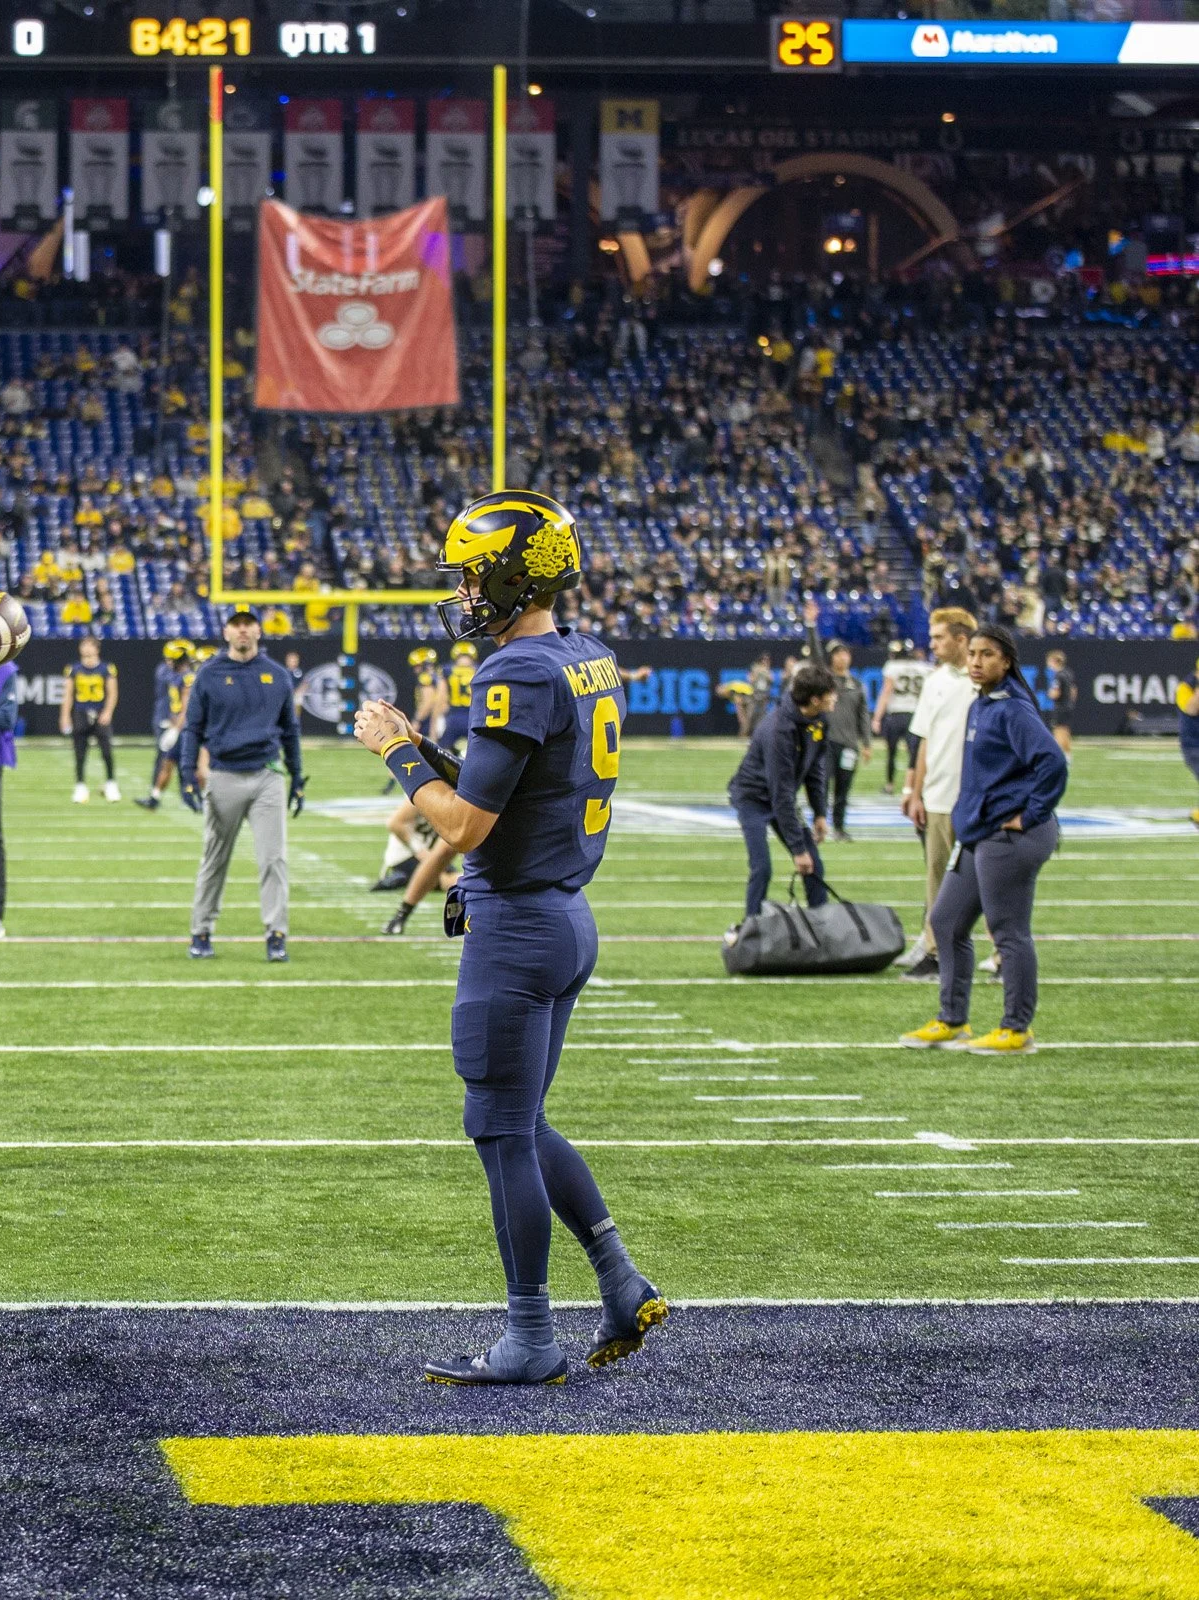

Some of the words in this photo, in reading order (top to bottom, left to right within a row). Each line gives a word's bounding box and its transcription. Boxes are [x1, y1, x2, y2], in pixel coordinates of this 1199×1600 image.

[13, 19, 45, 56] 0
[130, 18, 251, 56] 64:21
[280, 21, 350, 57] QTR
[356, 22, 376, 54] 1
[778, 21, 835, 66] 25
[952, 30, 1059, 54] Marathon
[15, 674, 66, 705] ME
[562, 655, 622, 698] McCARTHY
[628, 667, 711, 715] BIG
[484, 684, 511, 729] 9
